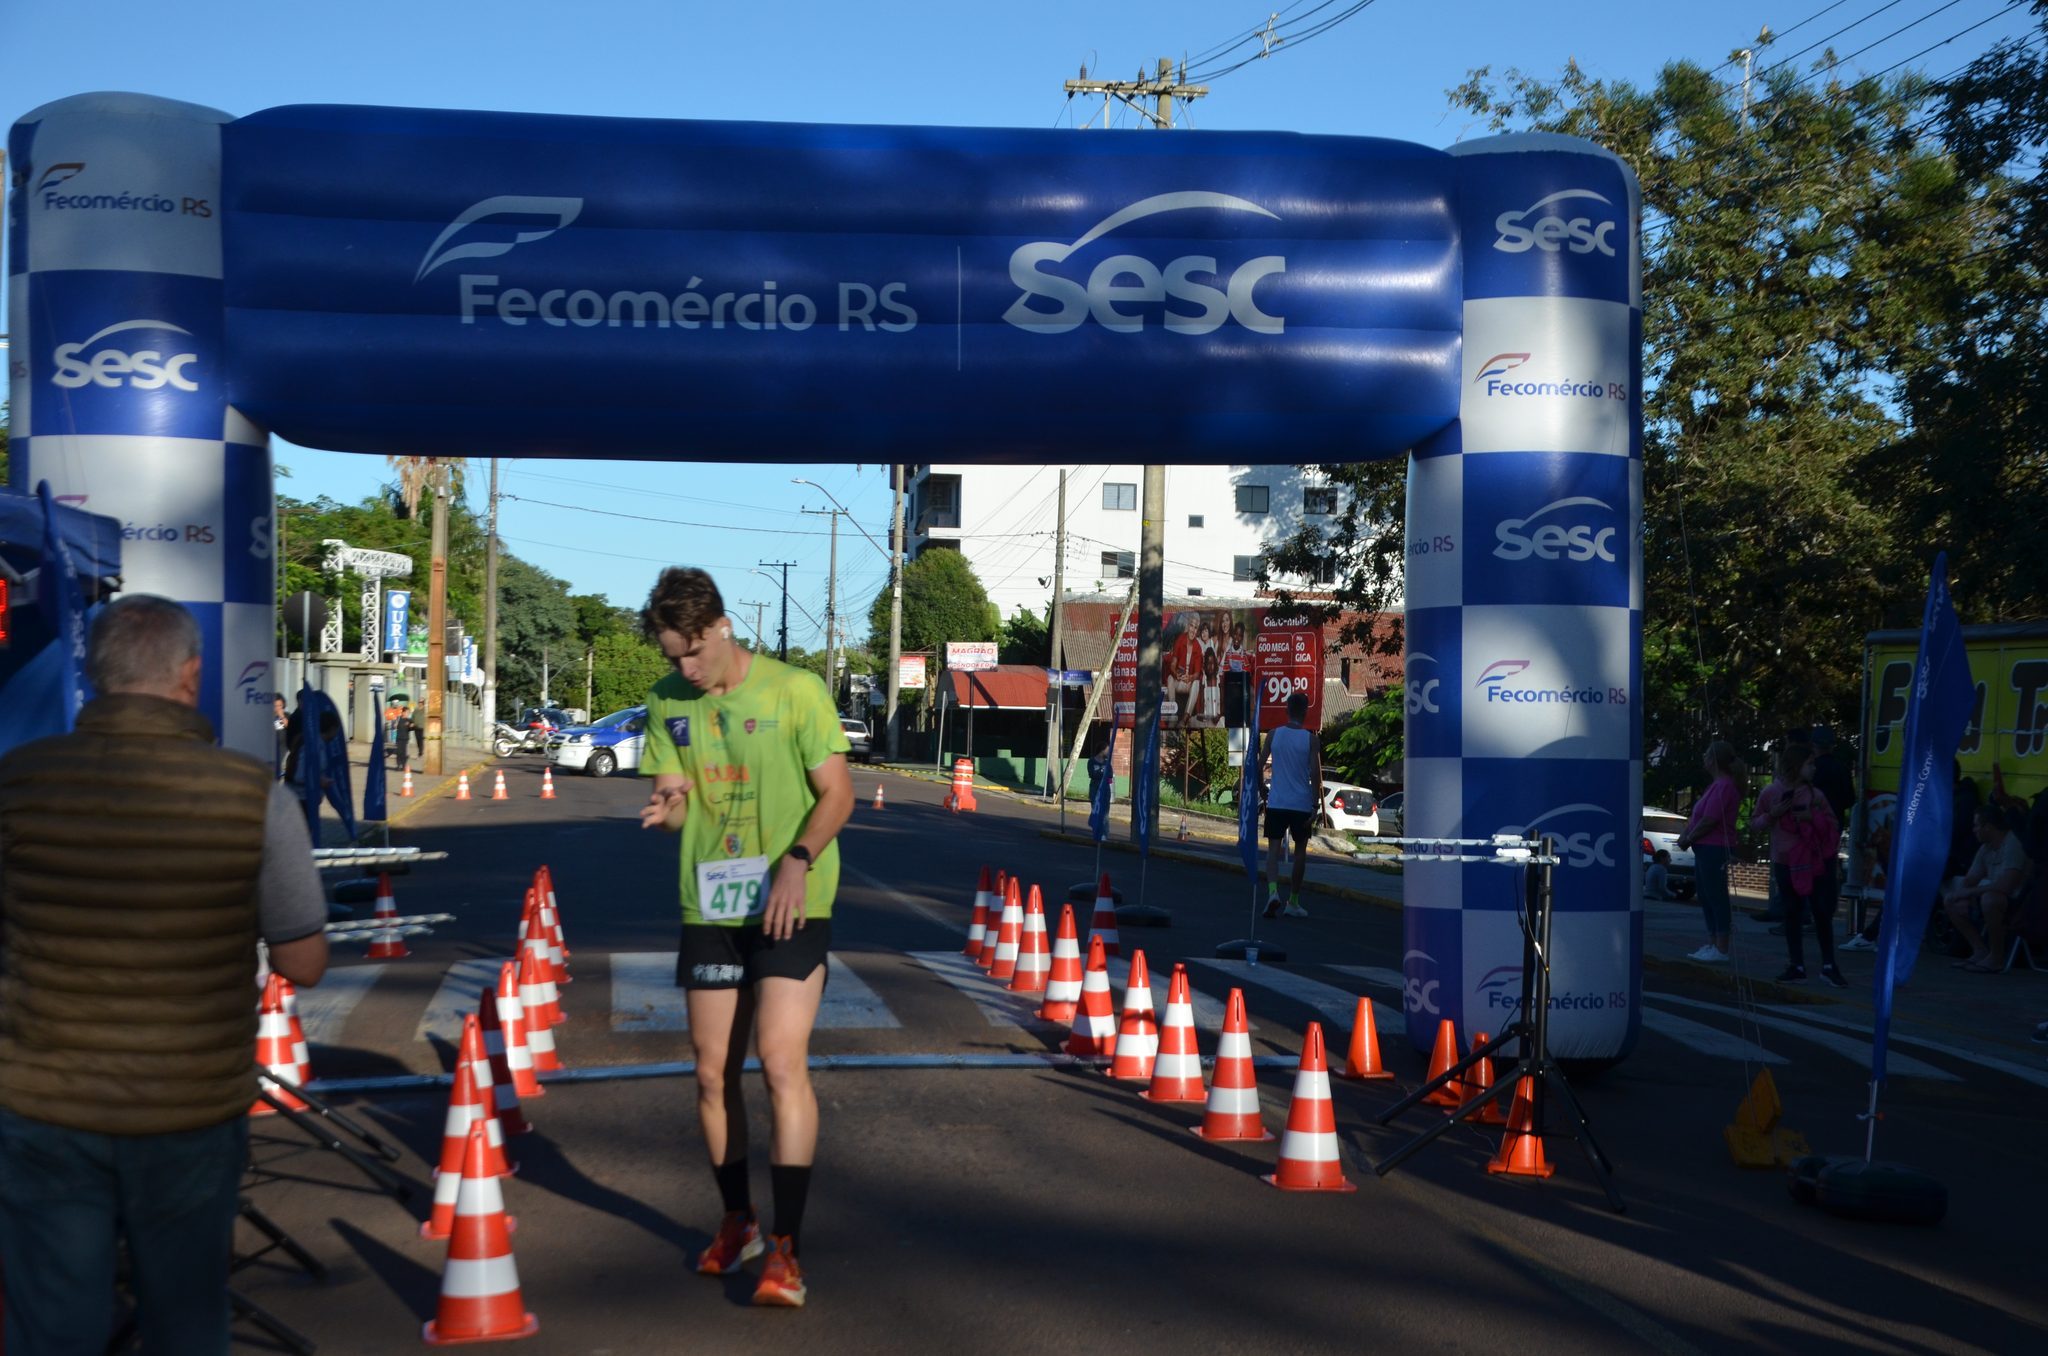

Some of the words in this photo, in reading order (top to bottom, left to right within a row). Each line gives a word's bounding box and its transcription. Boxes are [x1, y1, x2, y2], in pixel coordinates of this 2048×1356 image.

[45, 190, 174, 213] Fecomércio
[181, 197, 212, 218] RS
[459, 275, 817, 332] Fecomércio
[838, 282, 919, 333] RS
[1487, 378, 1604, 399] Fecomércio
[1607, 381, 1627, 401] RS
[184, 523, 216, 544] RS
[1433, 535, 1455, 553] RS
[390, 610, 405, 650] URI
[1258, 642, 1271, 652] 600
[1271, 642, 1290, 652] MEGA
[1295, 642, 1305, 652] 60
[1295, 653, 1312, 662] GIGA
[1487, 685, 1604, 705] Fecomércio
[1608, 687, 1627, 705] RS
[710, 880, 762, 914] 479
[1608, 991, 1627, 1009] RS
